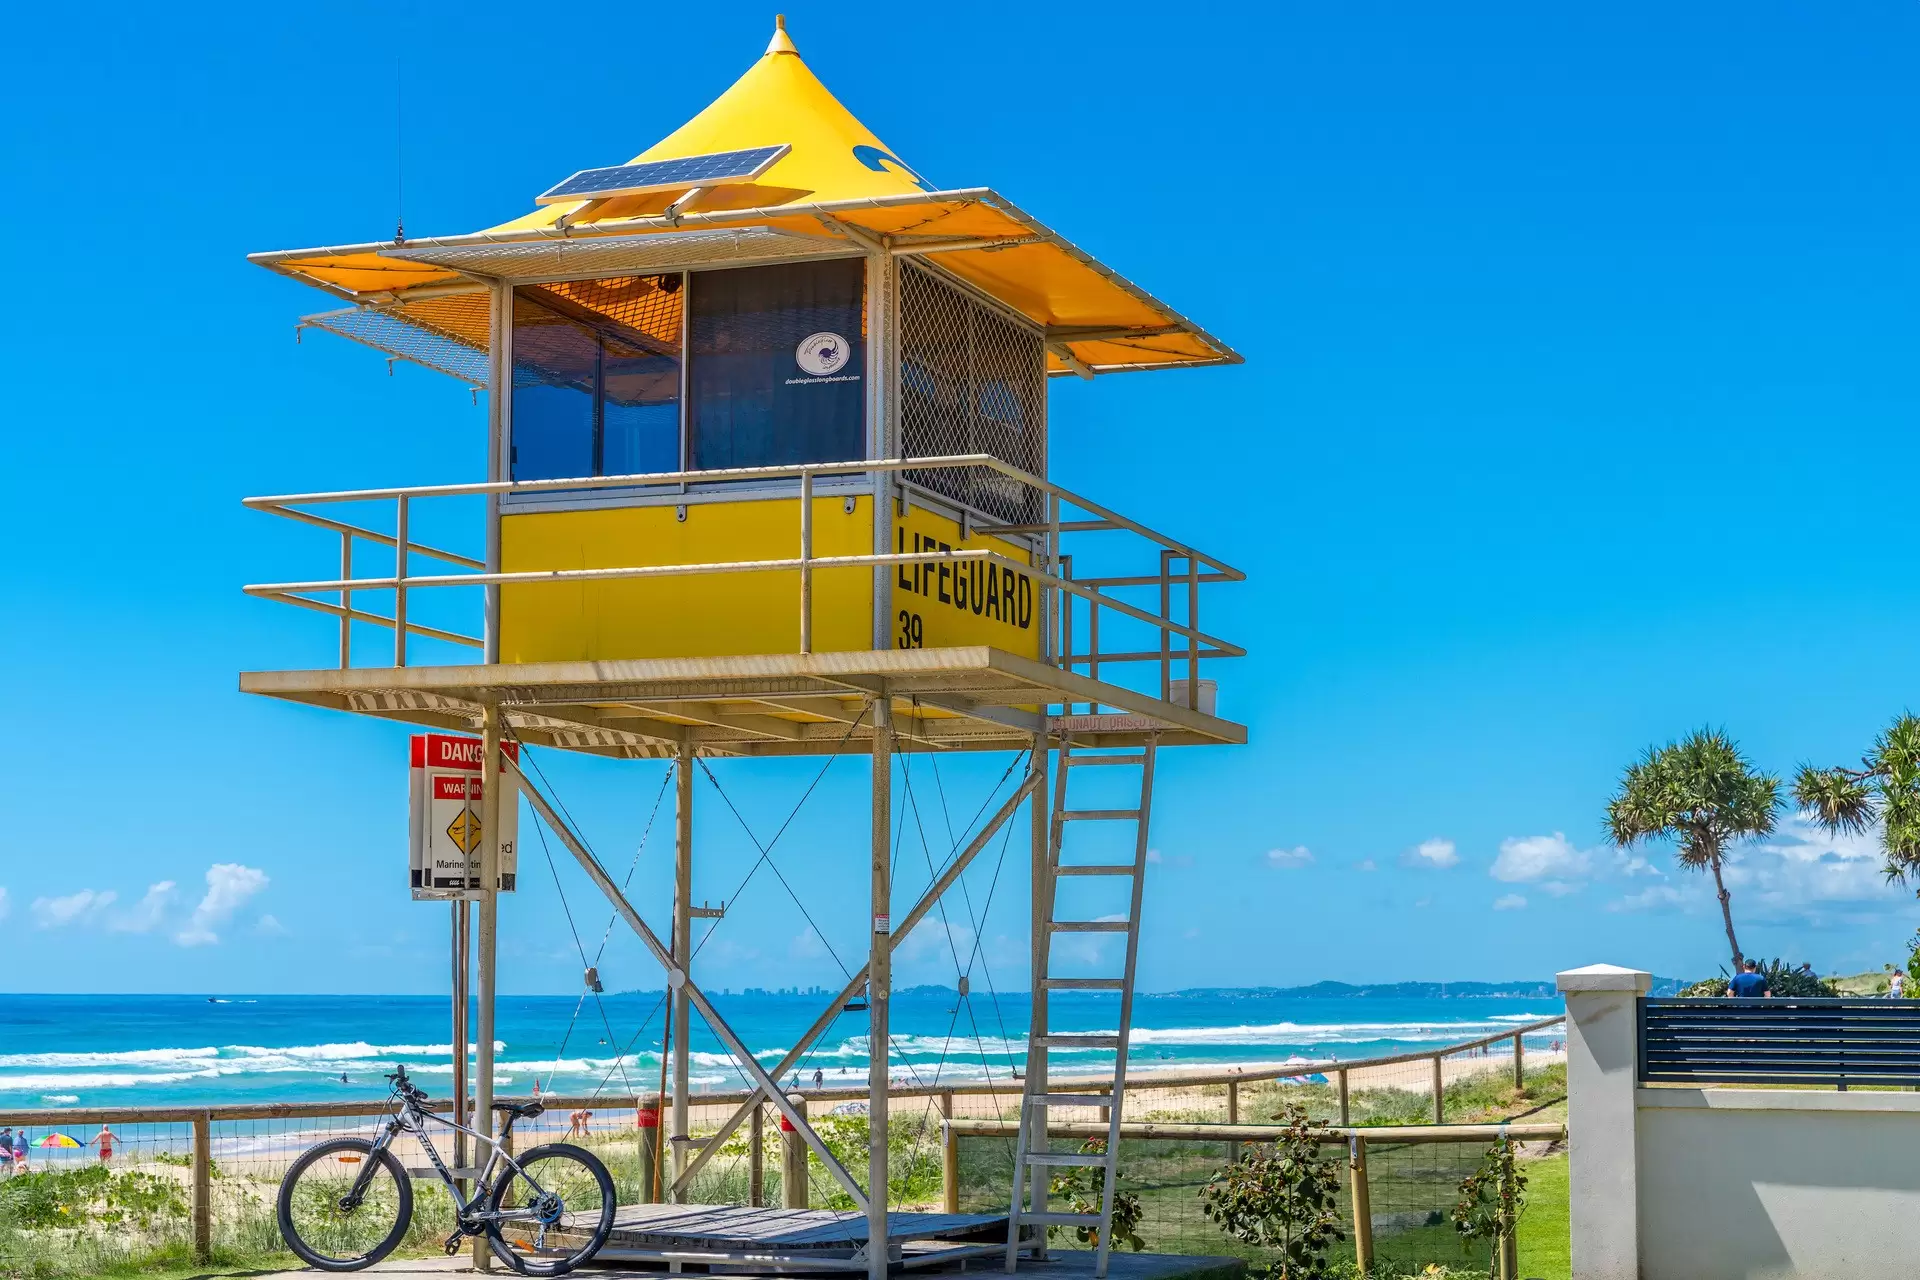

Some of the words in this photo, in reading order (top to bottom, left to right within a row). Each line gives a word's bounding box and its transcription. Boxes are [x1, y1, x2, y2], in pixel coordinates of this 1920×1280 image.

[785, 375, 860, 385] doubleglasslongboards.com
[898, 526, 1032, 629] LIFEGUARD
[899, 610, 923, 649] 39
[1069, 717, 1145, 730] UNAUTORISED
[442, 741, 483, 763] DANG
[436, 859, 465, 869] Marine
